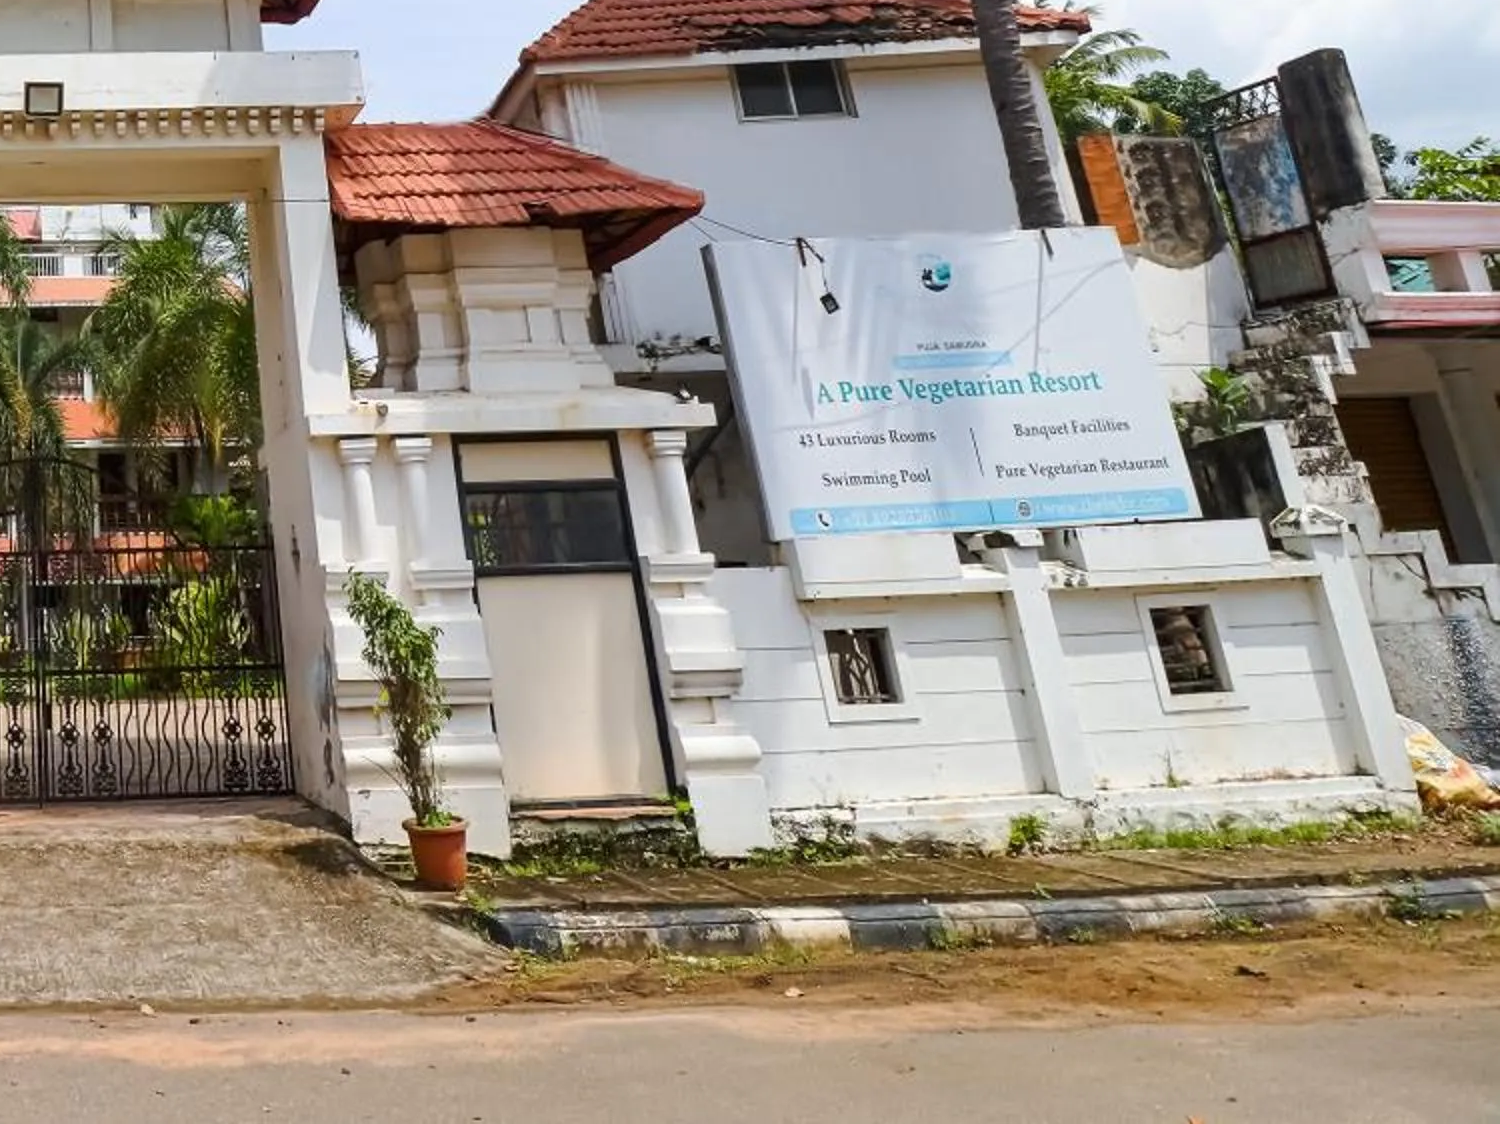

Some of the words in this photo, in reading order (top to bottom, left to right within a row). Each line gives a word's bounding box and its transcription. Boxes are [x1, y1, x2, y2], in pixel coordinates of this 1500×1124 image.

[817, 382, 834, 404] A
[838, 379, 893, 404] Pure
[899, 374, 1024, 405] Vegetarian
[1028, 370, 1103, 395] Resort
[799, 432, 814, 448] 43
[817, 432, 887, 447] Luxurious
[888, 428, 937, 444] Rooms
[1013, 422, 1069, 440] Banquet
[1071, 418, 1131, 435] Facilities
[821, 472, 899, 488] Swimming
[899, 467, 932, 483] Pool
[995, 464, 1027, 479] Pure
[1029, 460, 1098, 480] Vegetarian
[1100, 456, 1170, 473] Restaurant
